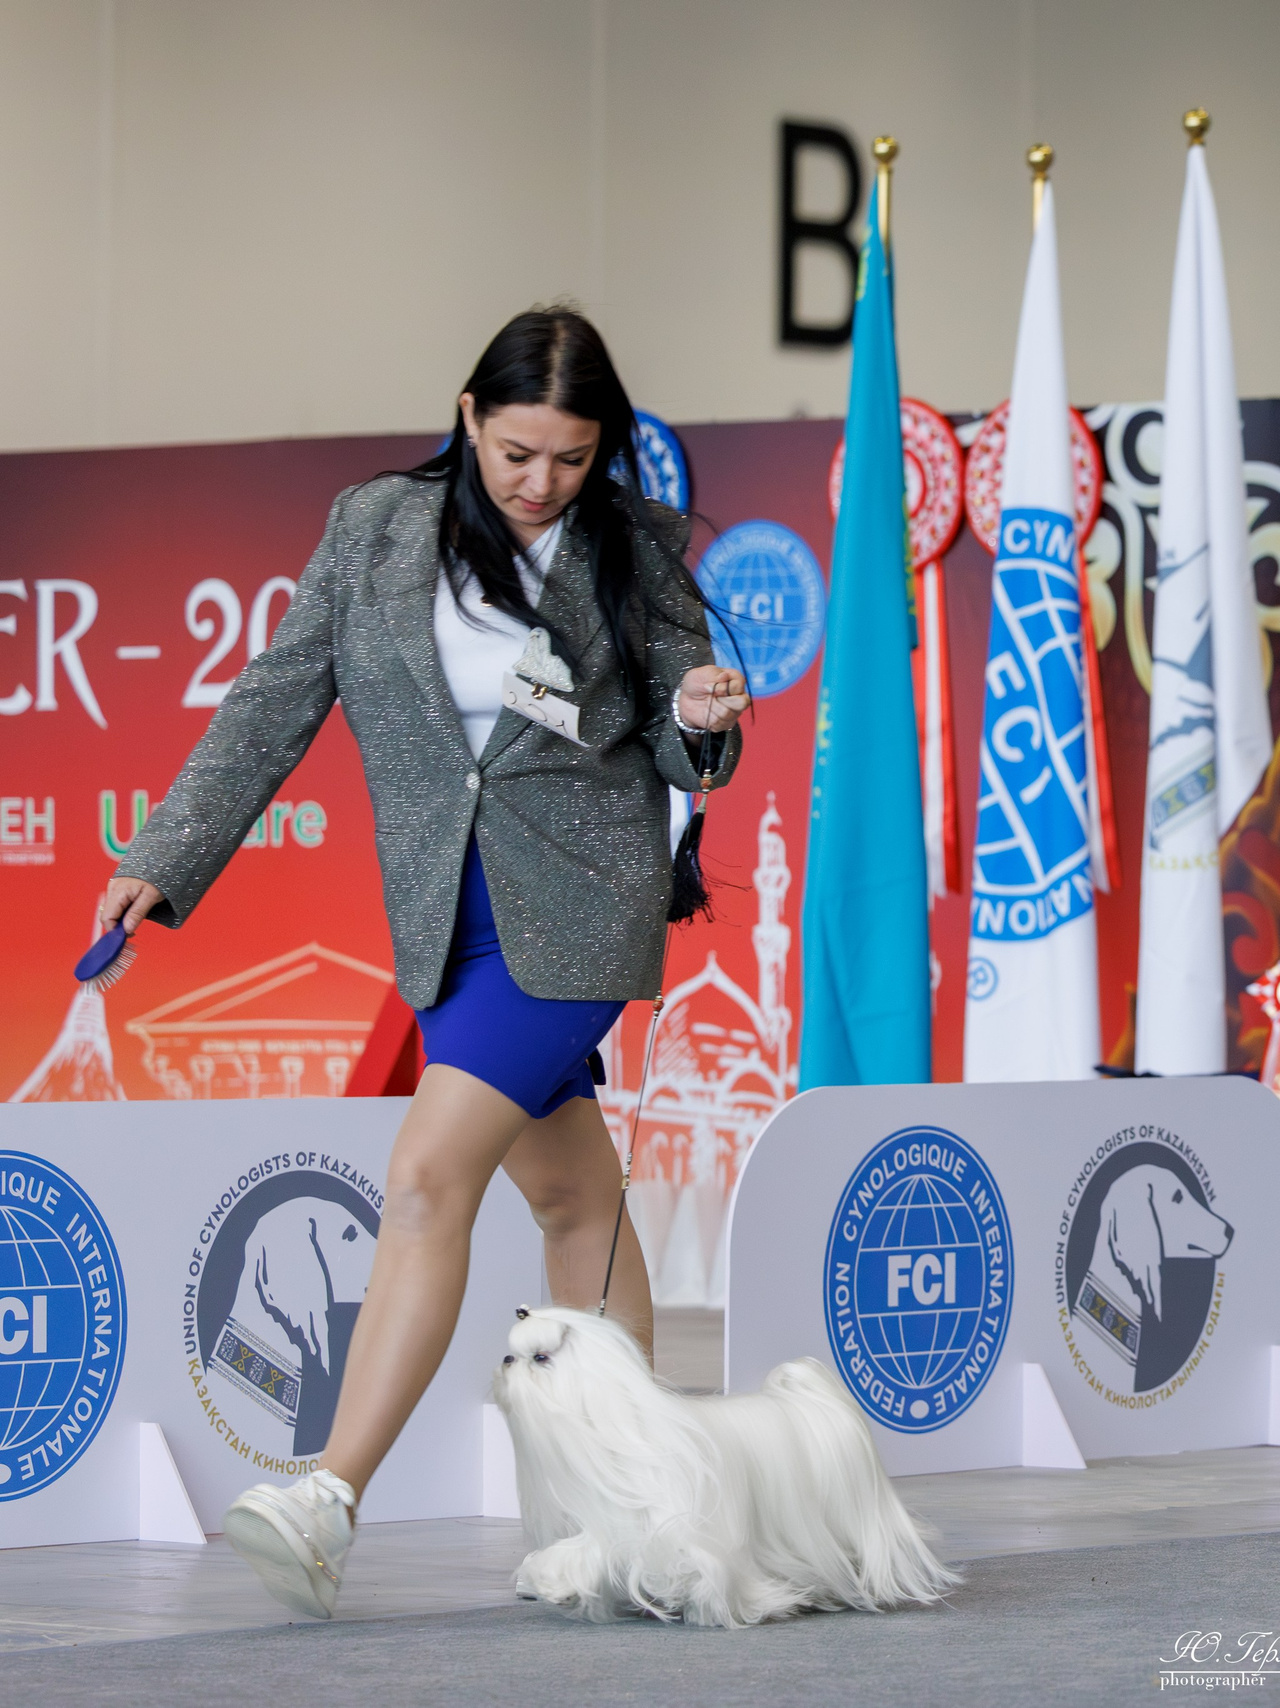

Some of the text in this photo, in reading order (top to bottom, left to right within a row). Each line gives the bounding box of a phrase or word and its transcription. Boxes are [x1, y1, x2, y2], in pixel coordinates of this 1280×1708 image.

[779, 119, 862, 348] B
[730, 592, 784, 625] FCI
[183, 1151, 385, 1355] UNION OF CYNOLOGISTS OF KAZAKHS
[835, 1143, 1004, 1419] FEDERATION CYNOLOGIQUE INTERNATIONALE
[887, 1252, 957, 1308] FCI
[1055, 1125, 1217, 1304] UNION OF CYNOLOGISTS OF KAZAKHSTAN
[18, 1212, 112, 1481] INTERNATIONALE
[252, 1450, 319, 1476] КИНОЛО
